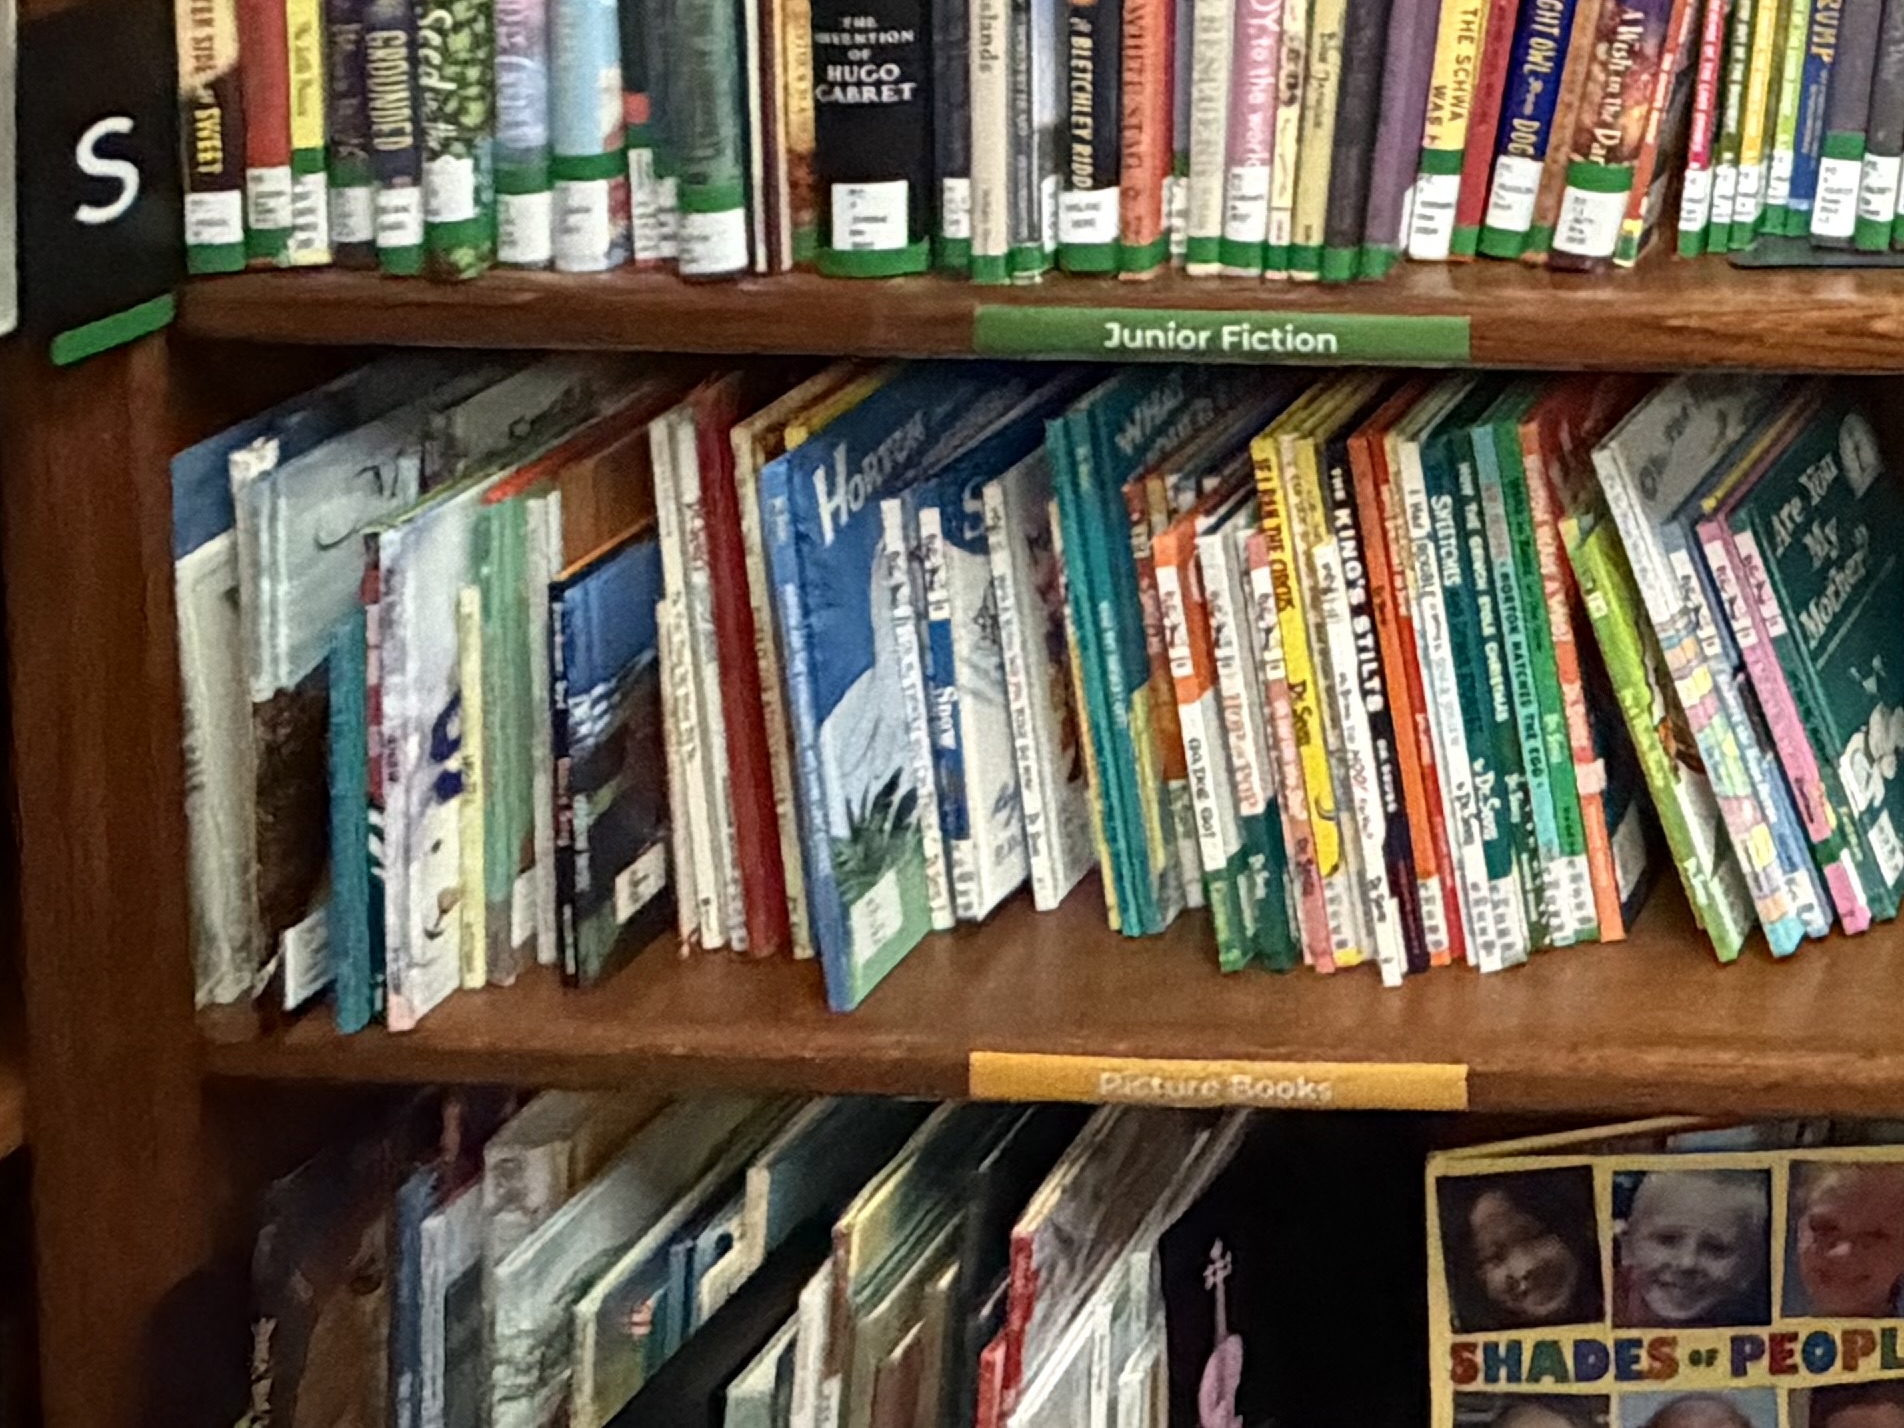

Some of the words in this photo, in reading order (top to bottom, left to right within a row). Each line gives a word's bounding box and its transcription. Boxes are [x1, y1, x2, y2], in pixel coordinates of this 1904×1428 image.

[825, 63, 901, 83] HUGO
[815, 81, 918, 105] CABRET
[75, 116, 141, 227] S
[1104, 322, 1210, 353] Junior
[1222, 324, 1337, 354] Fiction
[1100, 1073, 1218, 1101] Picture
[1231, 1075, 1332, 1103] Books
[1448, 1335, 1681, 1387] SHADES
[1688, 1346, 1718, 1367] OF
